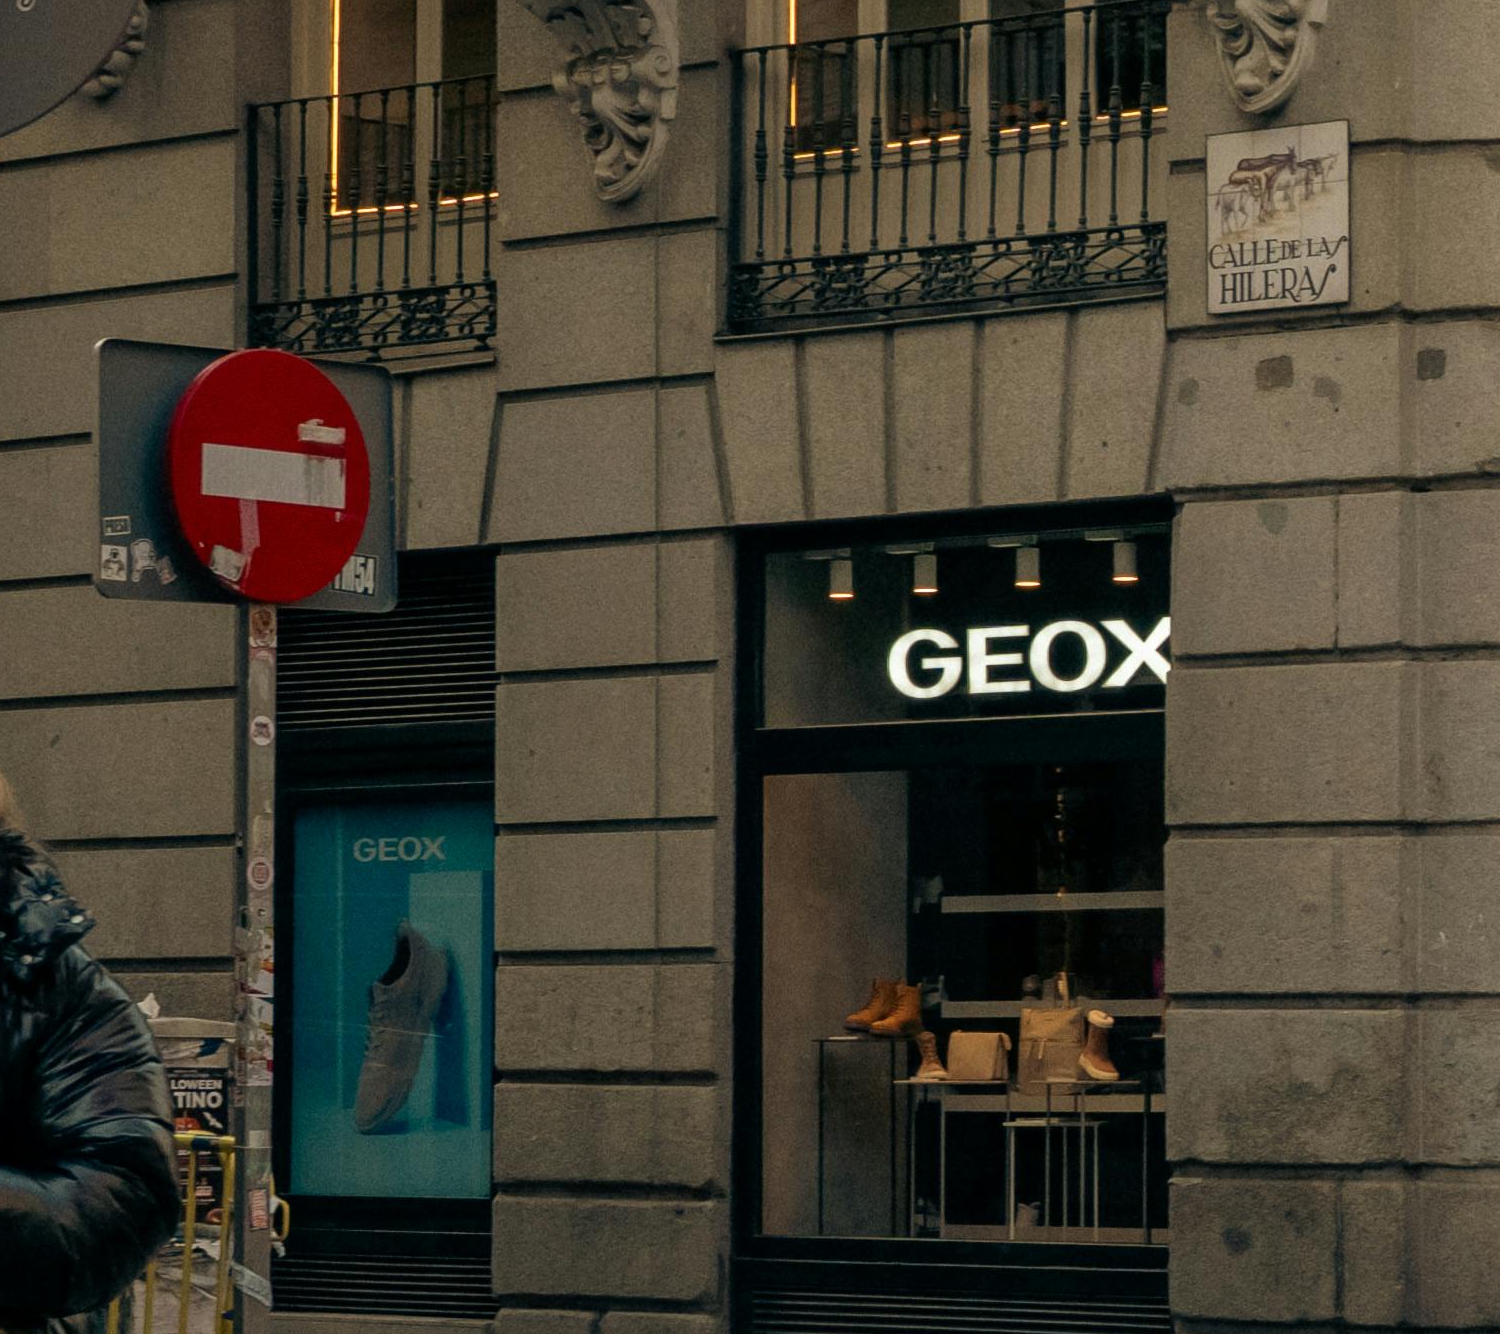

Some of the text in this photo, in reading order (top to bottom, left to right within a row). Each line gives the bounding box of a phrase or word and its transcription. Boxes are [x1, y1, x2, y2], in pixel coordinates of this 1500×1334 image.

[1209, 235, 1348, 269] CALLE DE LAS
[1220, 263, 1337, 304] HILERAS
[887, 616, 1172, 699] GEOX
[353, 835, 447, 862] GEOX
[170, 1079, 223, 1091] LOWEEN
[173, 1091, 224, 1109] TINO
